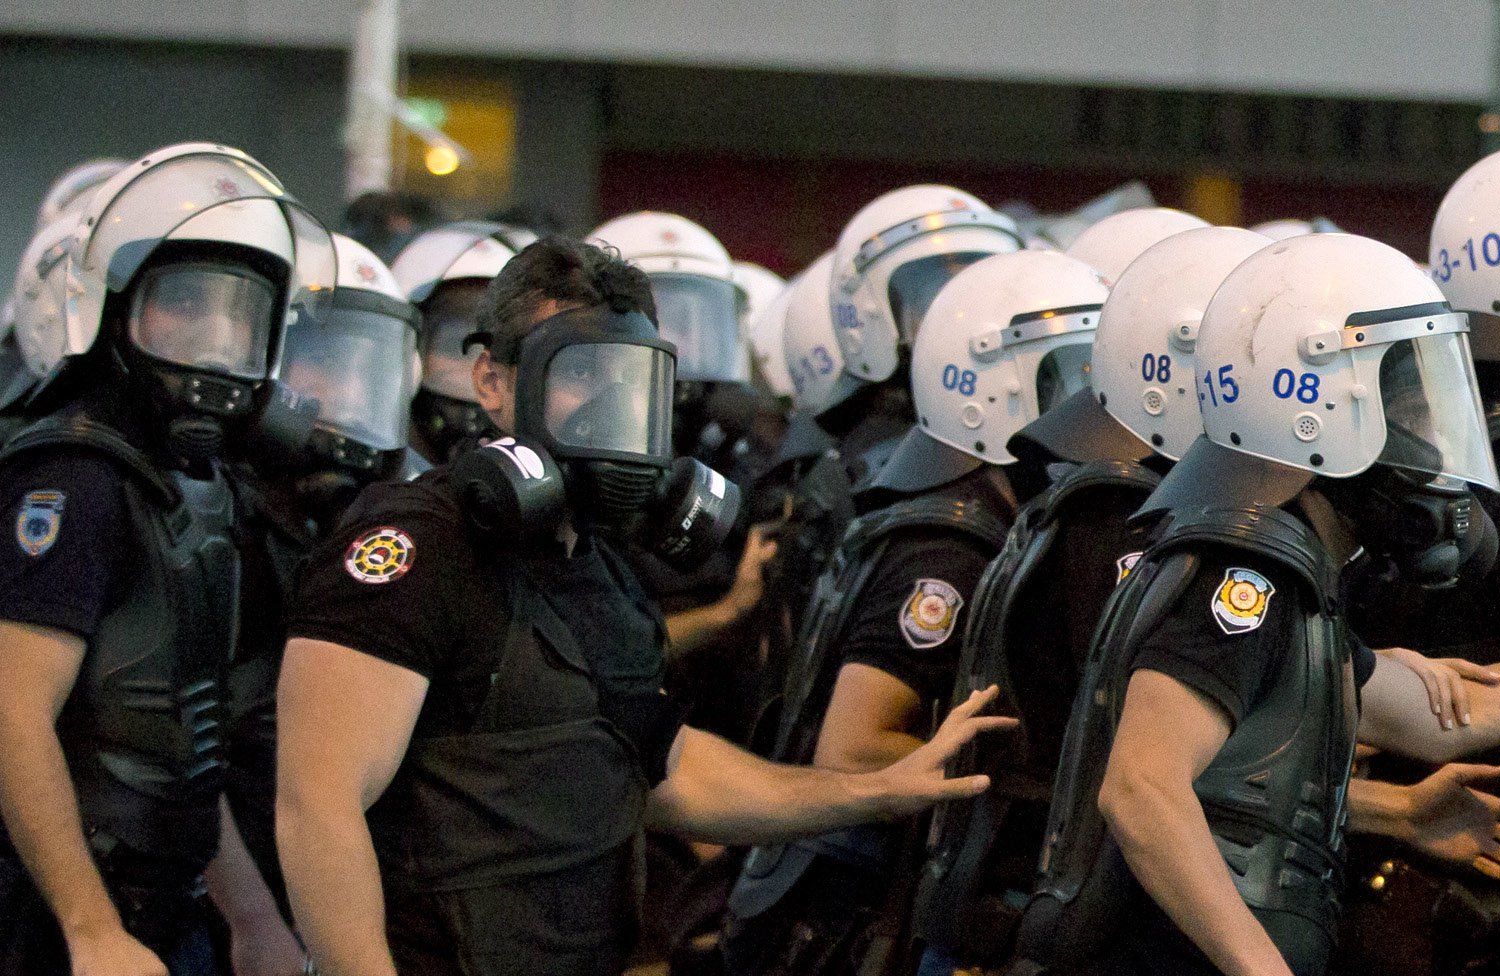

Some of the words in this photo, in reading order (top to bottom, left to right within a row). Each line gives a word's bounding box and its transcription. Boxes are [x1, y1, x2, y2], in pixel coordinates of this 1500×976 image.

[942, 363, 977, 397] 08
[1141, 353, 1171, 384] 08
[1273, 368, 1321, 404] 08
